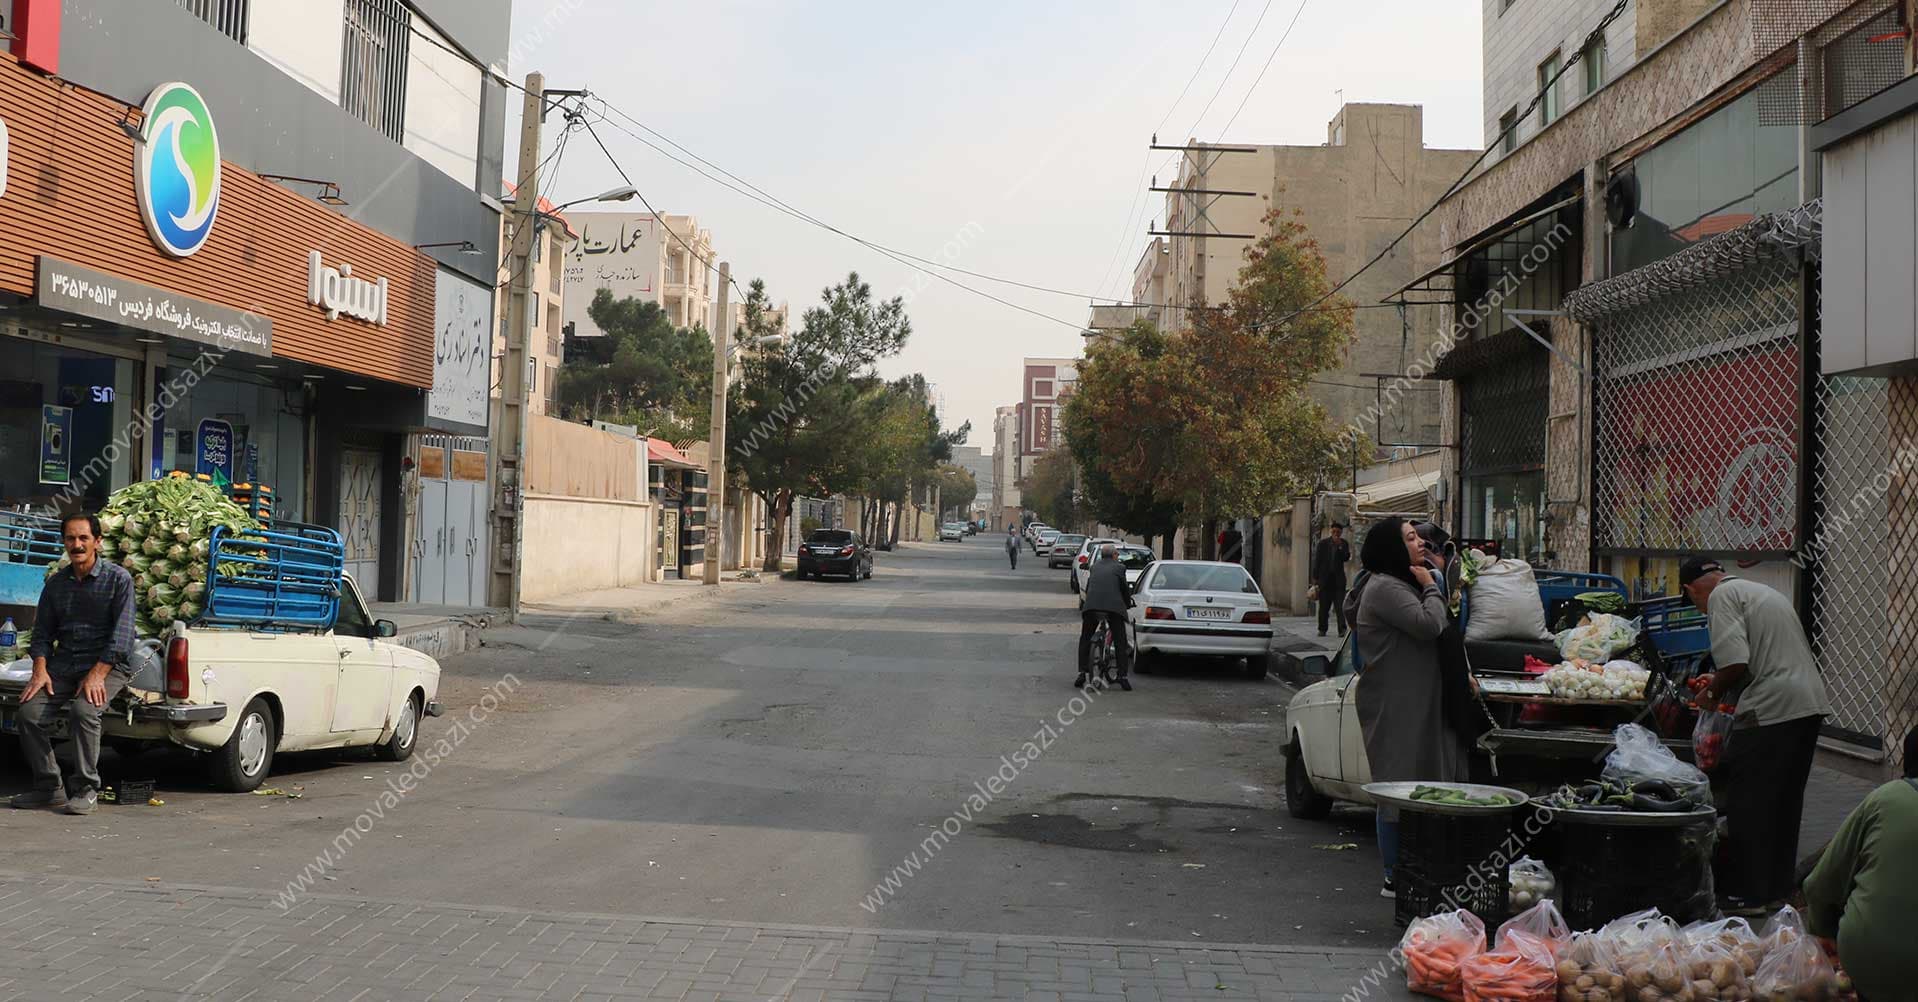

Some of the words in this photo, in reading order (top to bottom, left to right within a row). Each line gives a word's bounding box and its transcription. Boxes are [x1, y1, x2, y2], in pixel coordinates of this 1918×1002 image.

[583, 223, 642, 255] عمارت
[308, 250, 389, 327] اسنوا
[119, 297, 154, 321] فردیس
[155, 299, 191, 330] فروشگاه
[192, 317, 221, 336] الکترونیک
[221, 324, 242, 341] انتخاب
[242, 329, 262, 346] ضمانت
[261, 336, 268, 349] با
[466, 317, 484, 377] دفتر
